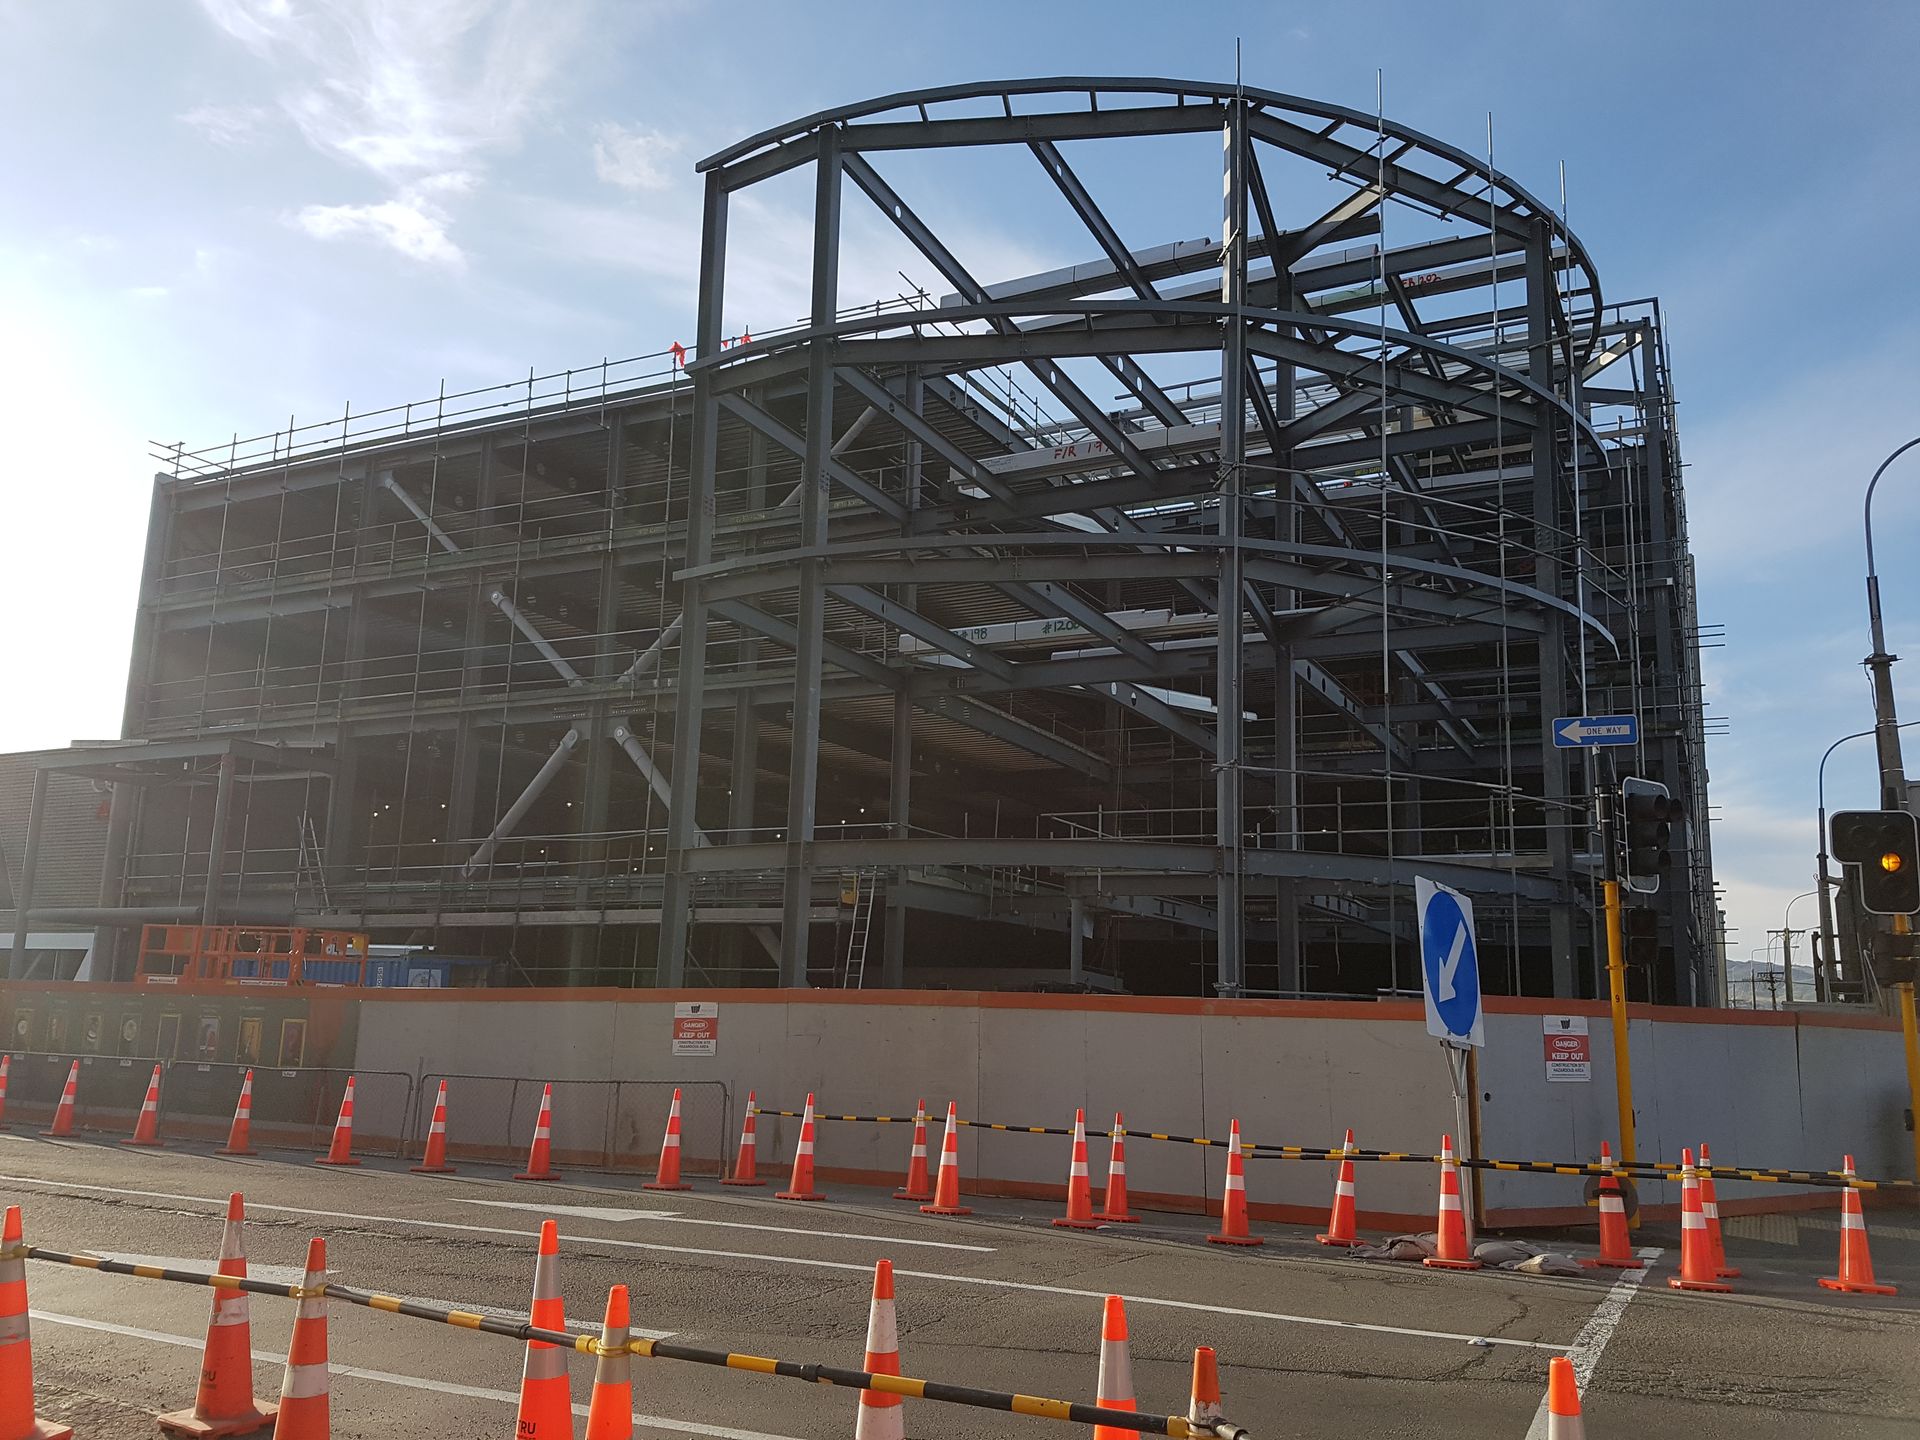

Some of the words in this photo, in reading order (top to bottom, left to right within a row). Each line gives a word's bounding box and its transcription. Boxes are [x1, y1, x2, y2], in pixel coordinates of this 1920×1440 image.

[1054, 446, 1076, 459] F/R
[1087, 441, 1110, 453] 19
[1586, 727, 1603, 735] ONE
[1605, 726, 1622, 734] WAY
[1615, 994, 1620, 1003] 9
[1555, 1040, 1578, 1048] DANGER
[1552, 1052, 1569, 1060] KEEP
[1571, 1052, 1584, 1060] OUT
